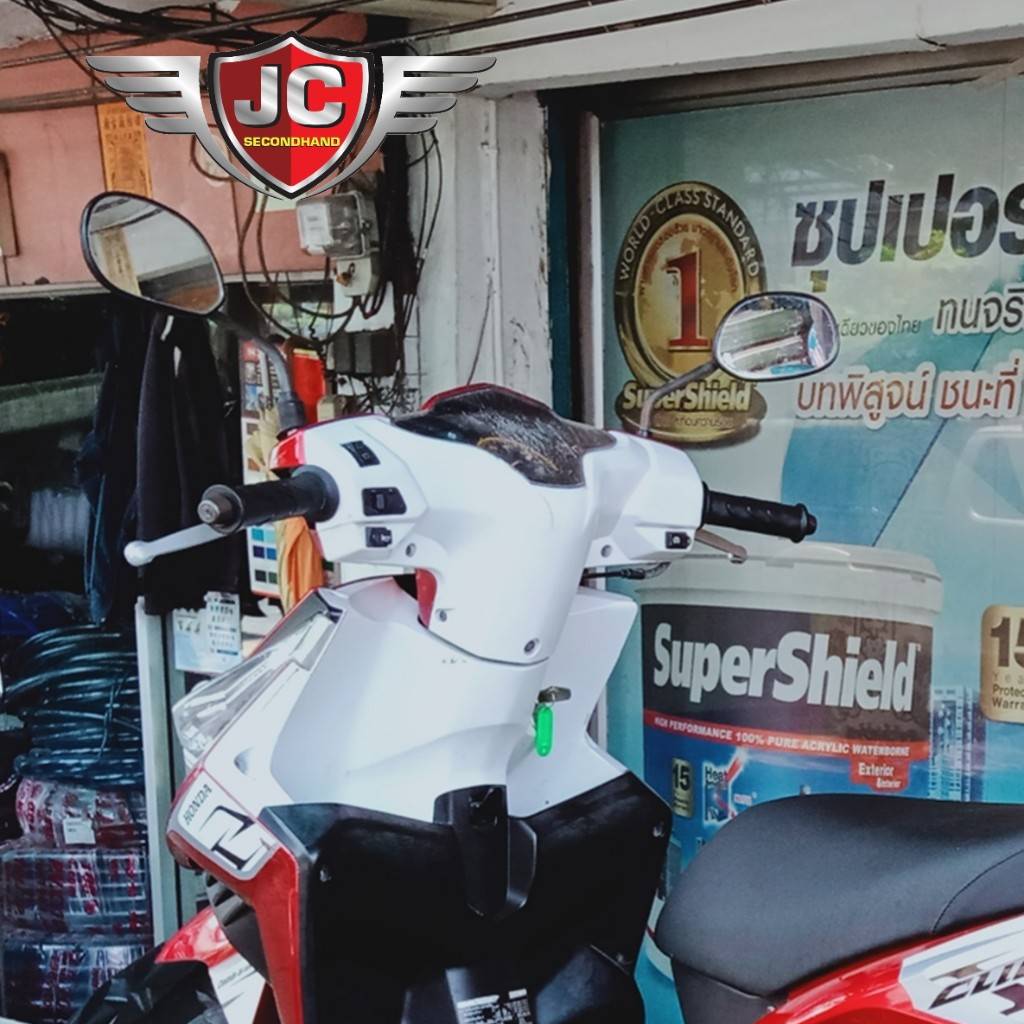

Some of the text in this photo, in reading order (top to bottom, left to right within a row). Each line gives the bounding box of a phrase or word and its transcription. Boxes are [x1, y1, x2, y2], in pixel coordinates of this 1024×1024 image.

[703, 191, 760, 277] STANDARD
[666, 252, 711, 353] 1
[798, 369, 929, 419] บทพิสูจน์
[940, 358, 1020, 410] ชนะที่
[653, 623, 916, 712] SuperShield
[669, 720, 732, 741] PERFORMANCE
[736, 732, 765, 746] 100%
[767, 735, 798, 750] PURE
[799, 739, 849, 755] ACRYLIC
[852, 743, 910, 757] WATERBORNE
[673, 764, 691, 791] 15
[858, 762, 895, 778] Exterior
